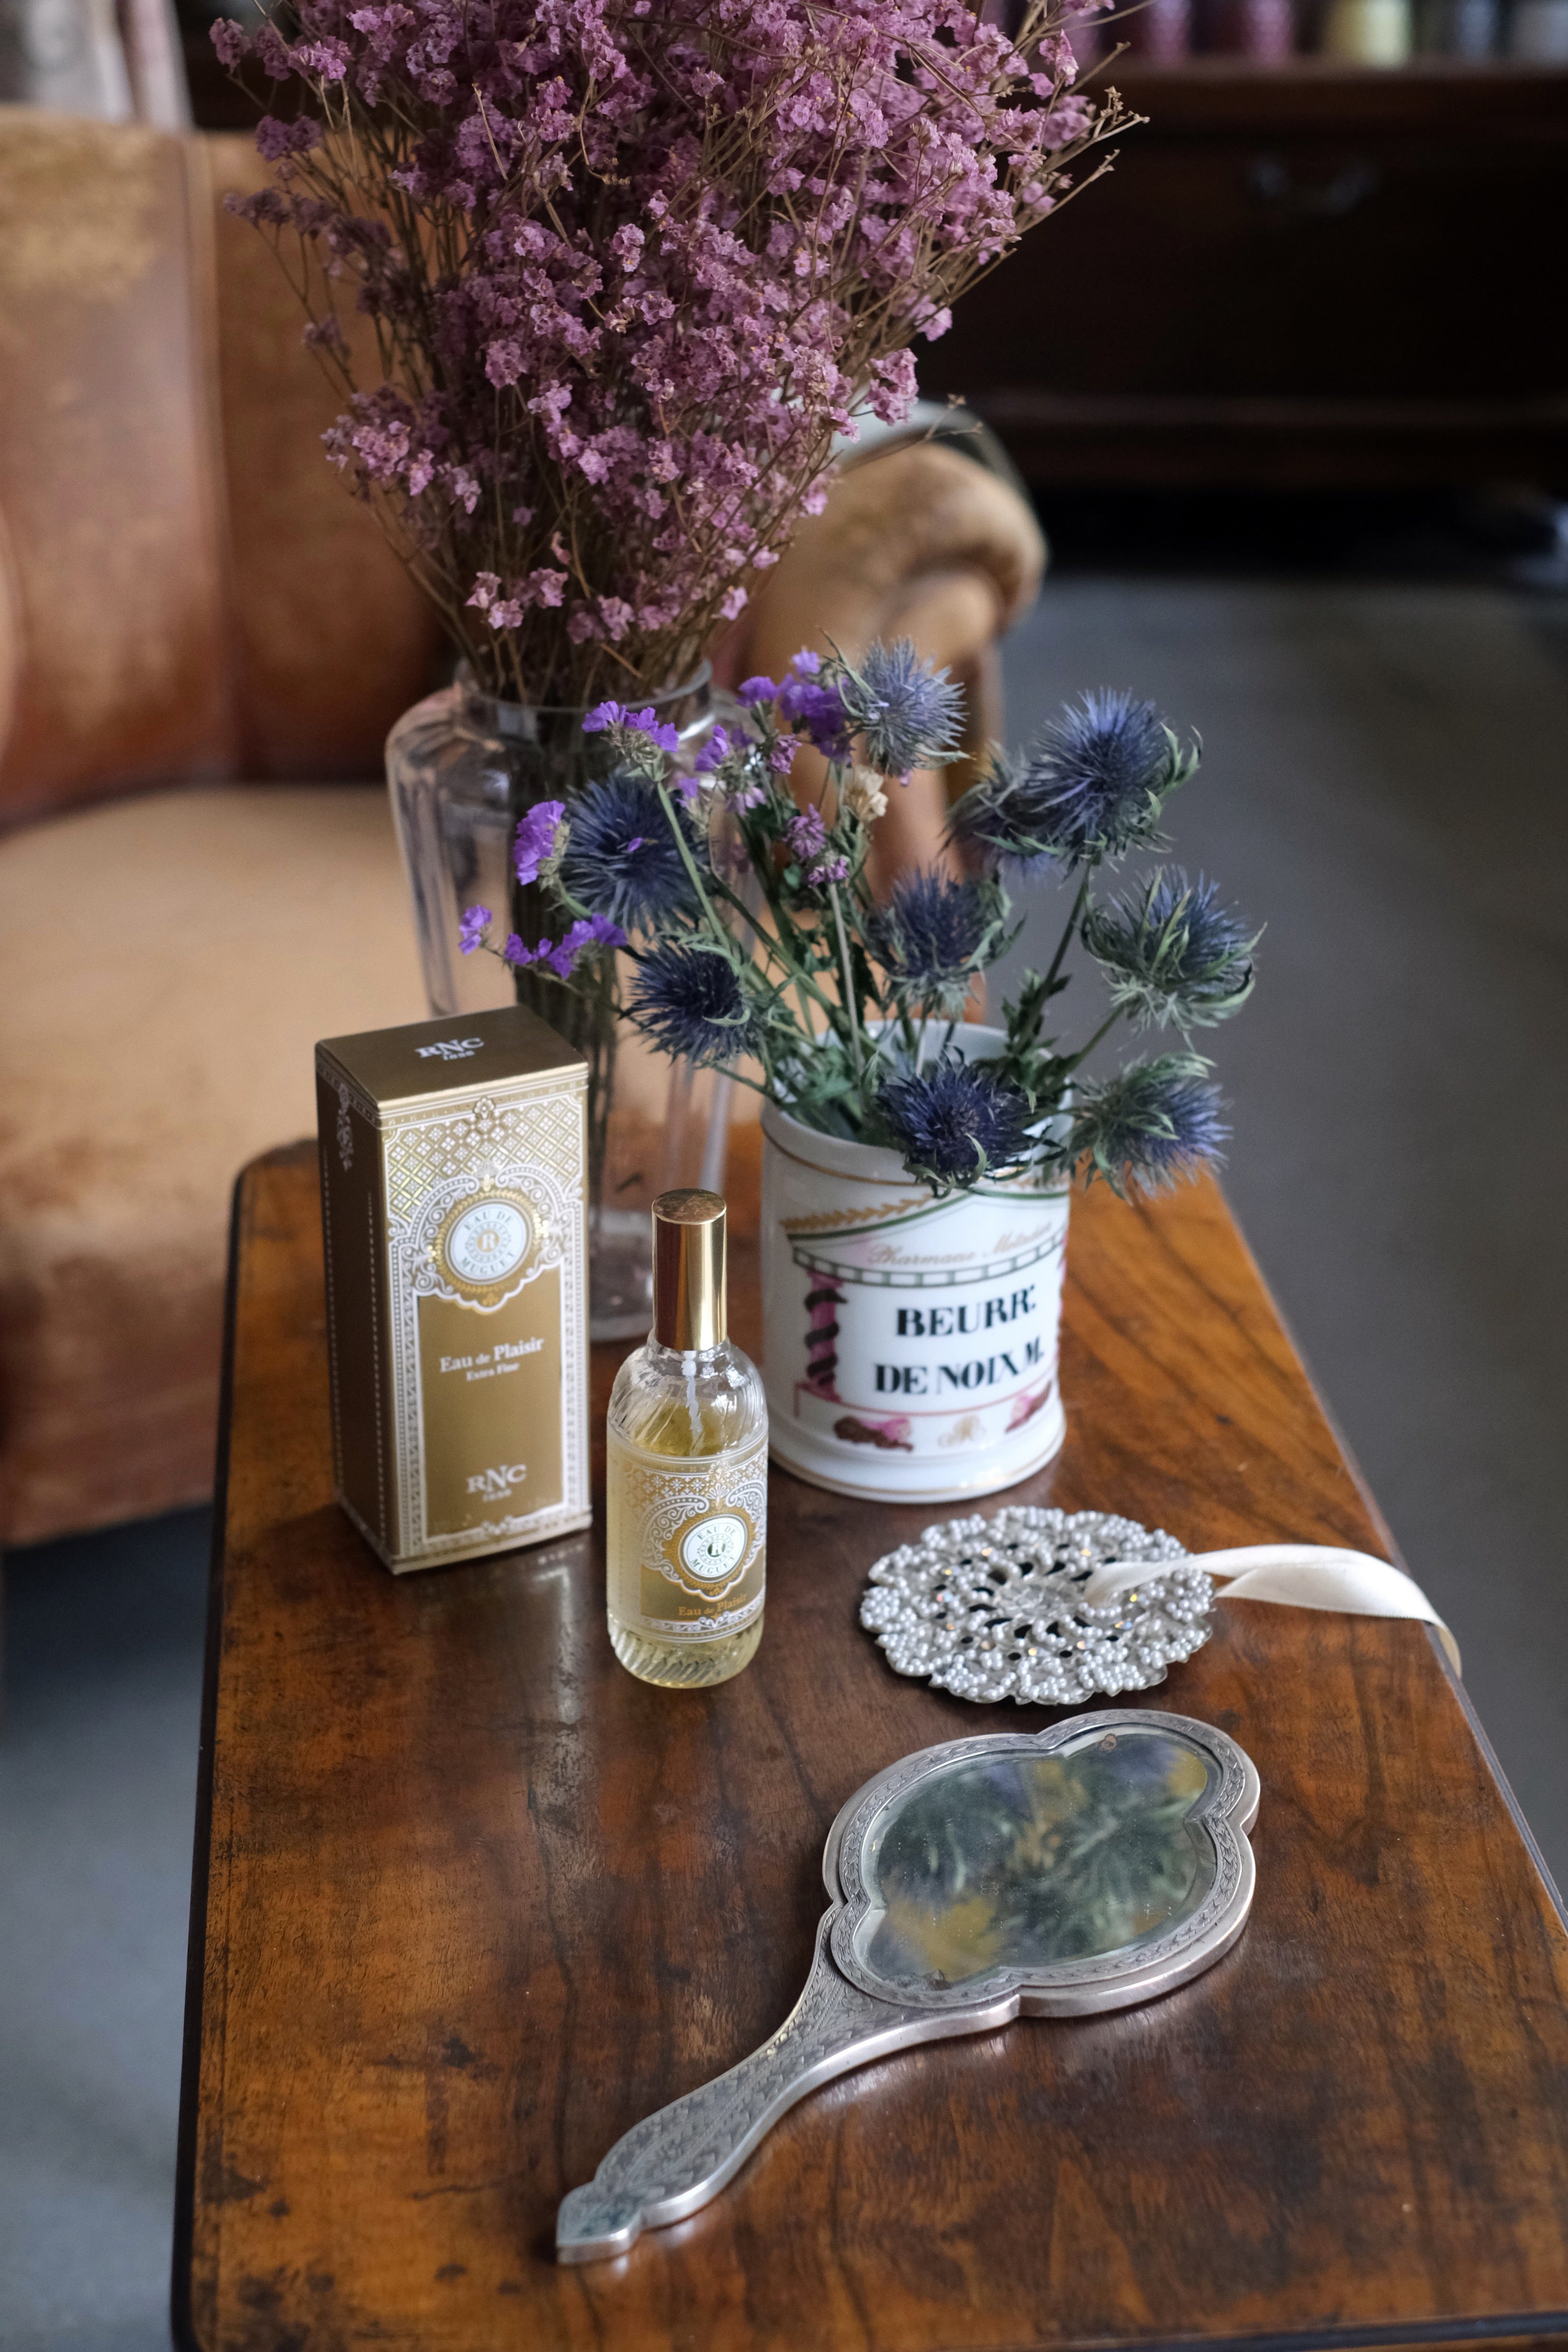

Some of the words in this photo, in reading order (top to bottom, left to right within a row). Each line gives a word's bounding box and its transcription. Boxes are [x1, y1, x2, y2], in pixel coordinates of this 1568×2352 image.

[414, 1037, 485, 1058] RNC
[440, 1355, 473, 1373] Eau
[476, 1353, 491, 1365] de
[493, 1336, 544, 1362] Plaisir
[874, 1364, 928, 1394] DE
[936, 1351, 1019, 1394] NOIX
[466, 1464, 527, 1493] RNC
[697, 1526, 720, 1540] EAU
[724, 1526, 737, 1537] DE
[691, 1555, 734, 1574] MUGUET
[678, 1607, 701, 1616] Eau
[717, 1594, 747, 1612] Plaisir
